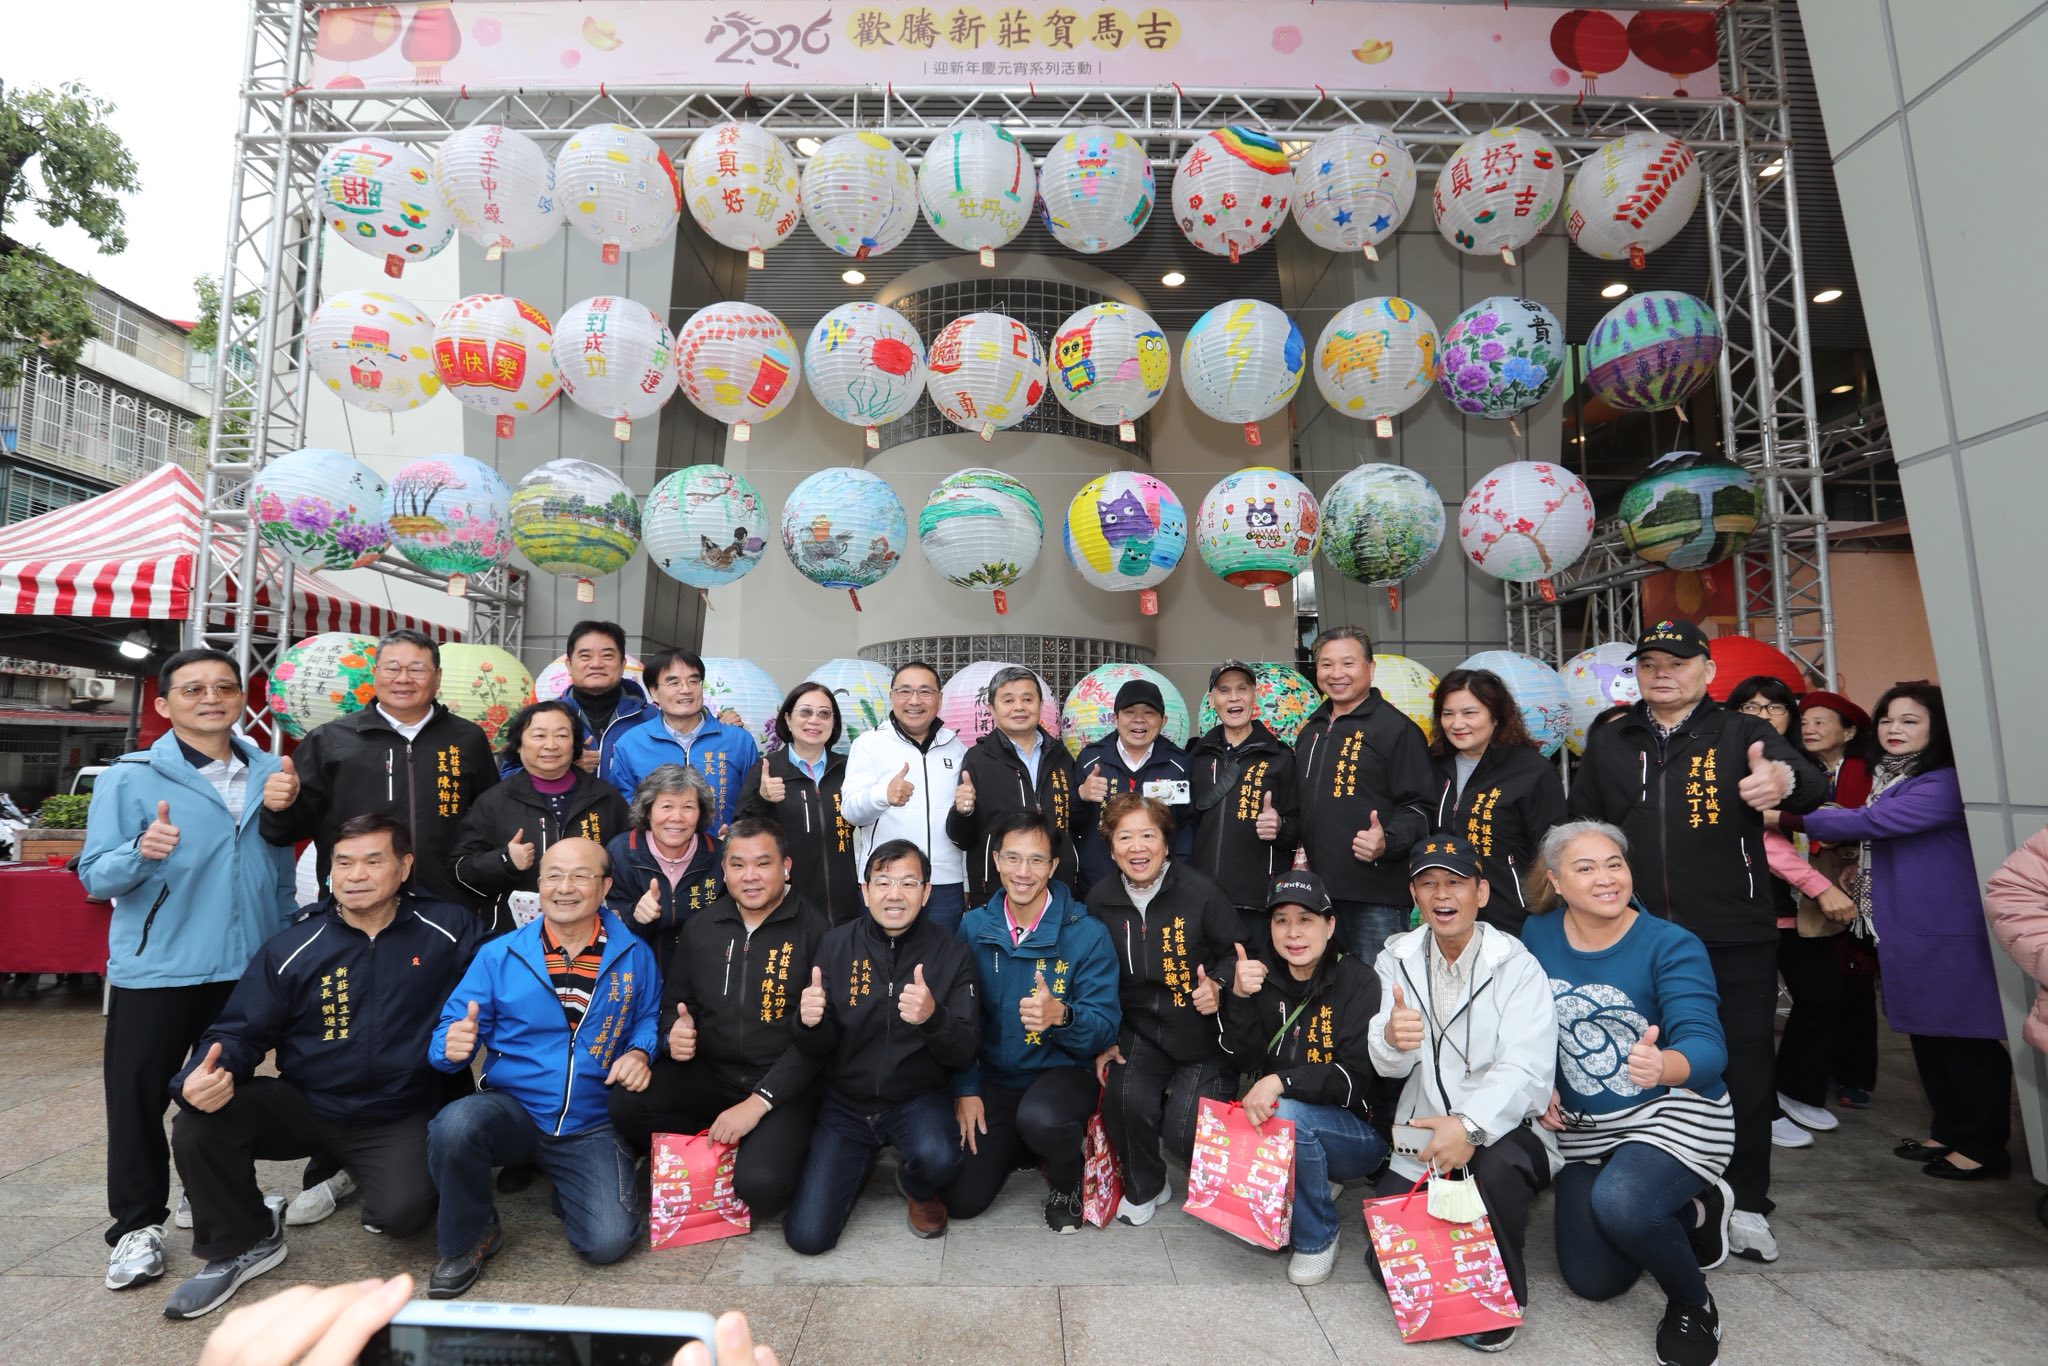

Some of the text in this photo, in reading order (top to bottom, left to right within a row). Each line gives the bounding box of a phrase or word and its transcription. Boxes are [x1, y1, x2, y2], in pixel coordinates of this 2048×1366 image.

[705, 7, 832, 70] 2026
[854, 8, 1172, 50] 歡騰新莊賀馬吉
[932, 60, 1093, 77] 迎新年慶元宵系列活動
[717, 122, 745, 214] 錢真好
[1184, 148, 1212, 177] 春
[437, 751, 449, 772] 里長
[448, 745, 461, 814] 新莊區 中全里
[703, 752, 716, 776] 里長
[1254, 761, 1269, 787] 新莊區
[1333, 737, 1352, 797] 里長 黃永昌
[1346, 730, 1364, 796] 新莊區 中原里
[1053, 793, 1064, 829] 林阿元
[1471, 793, 1486, 814] 里長
[1483, 787, 1502, 820] 新莊區
[1686, 756, 1704, 829] 里長 沈丁子
[1705, 785, 1720, 824] 中誠里
[1424, 842, 1458, 855] 里長
[689, 885, 701, 910] 里長
[1162, 926, 1173, 953] 里長
[1173, 916, 1193, 994] 新莊區 文明里
[765, 949, 779, 974] 里長
[774, 941, 794, 1019] 新莊區 立功里
[860, 959, 872, 996] 民政局
[335, 966, 351, 1040] 新莊區立言里
[608, 972, 621, 1003] 里長
[319, 975, 337, 1041] 里長 劉進益
[1319, 1004, 1334, 1049] 新莊區
[1307, 1015, 1323, 1064] 里長 陳
